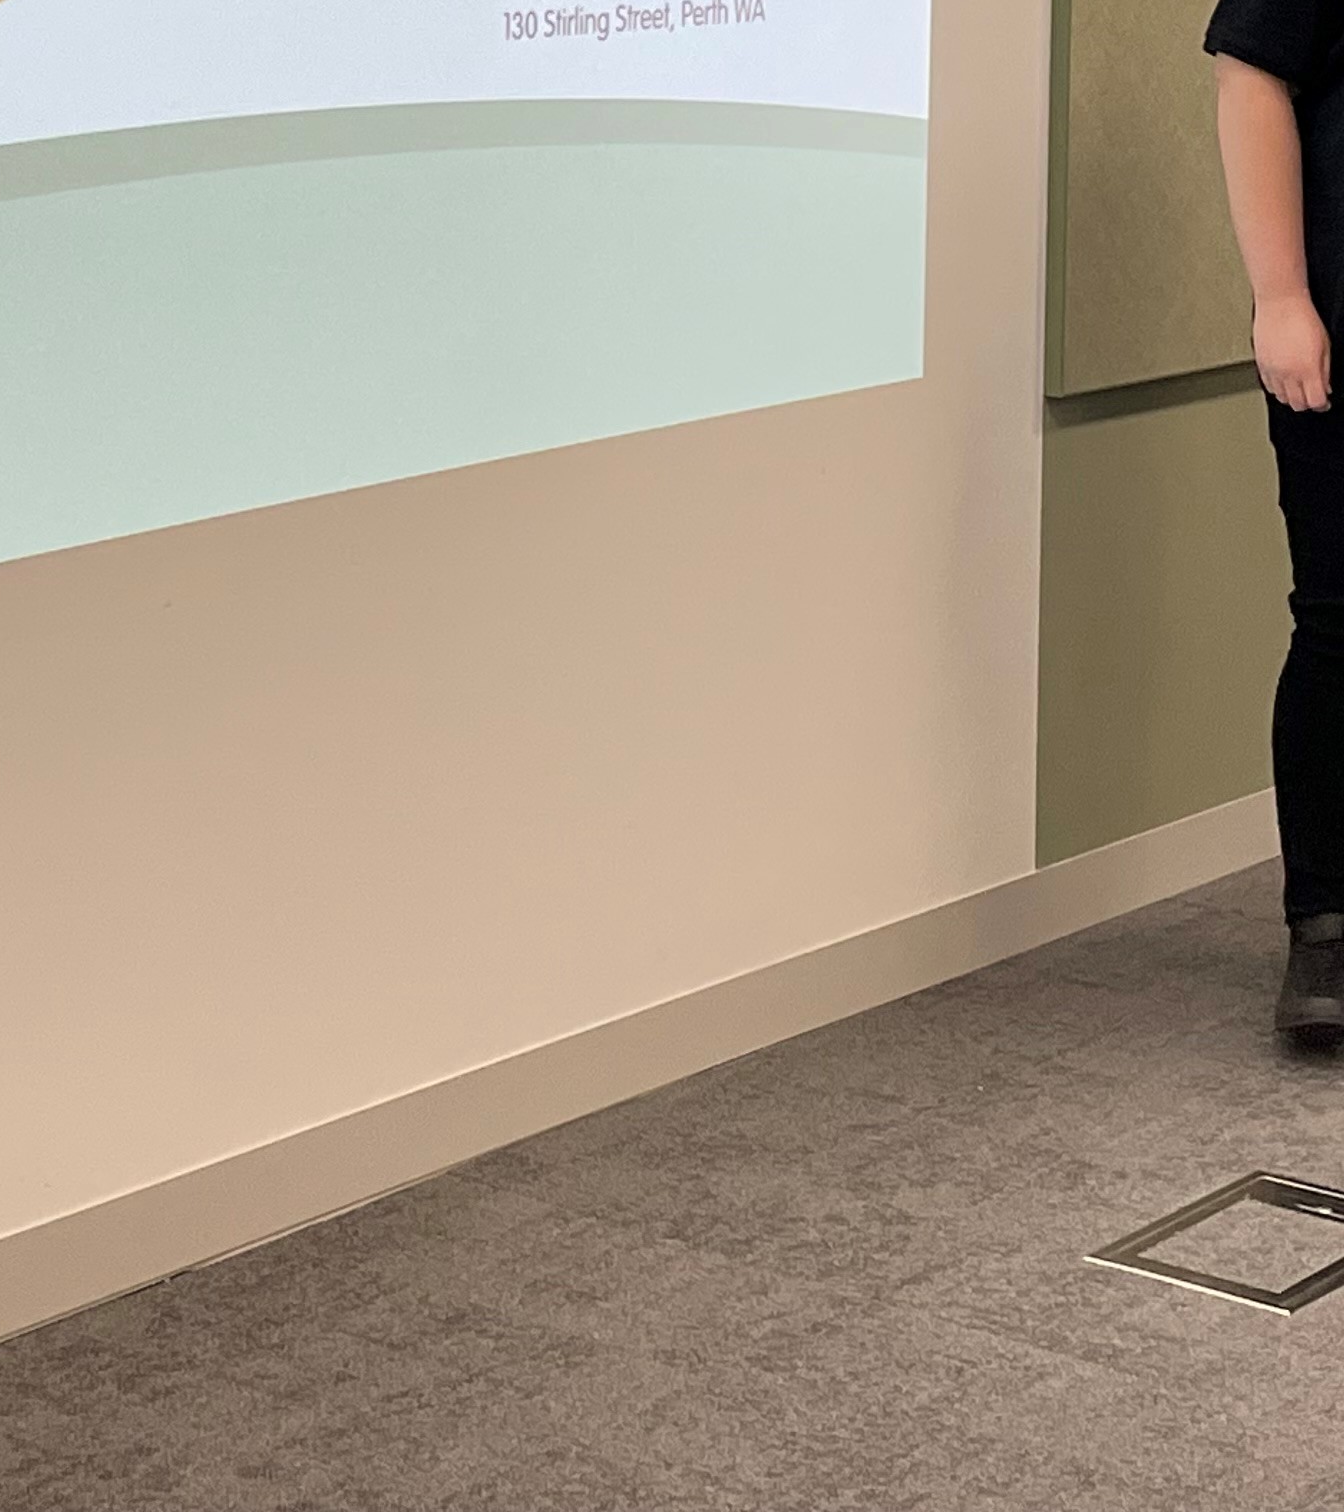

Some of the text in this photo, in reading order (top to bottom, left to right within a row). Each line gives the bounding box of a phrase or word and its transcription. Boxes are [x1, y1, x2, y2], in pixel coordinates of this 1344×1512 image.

[503, 11, 538, 41] 130
[544, 5, 610, 41] Stirling
[615, 2, 675, 33] Street,
